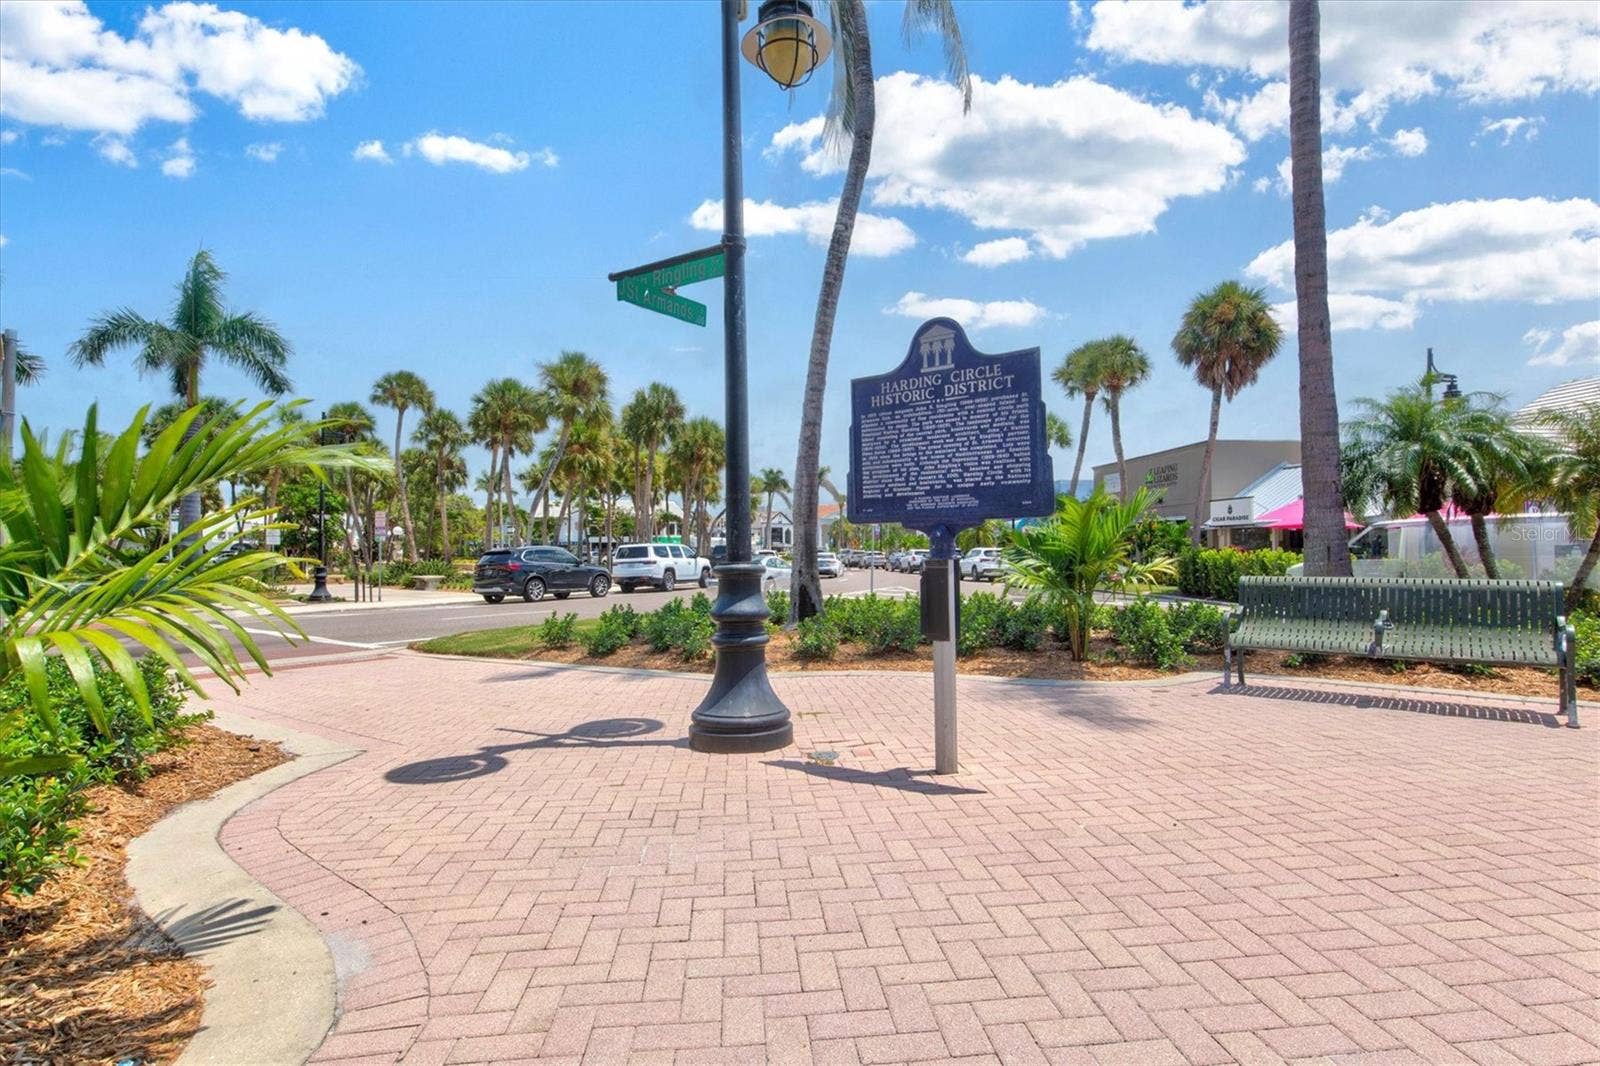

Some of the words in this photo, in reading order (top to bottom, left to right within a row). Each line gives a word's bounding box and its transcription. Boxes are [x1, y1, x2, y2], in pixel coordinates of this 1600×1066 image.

[652, 261, 706, 286] Ringling
[643, 294, 693, 318] Armands
[871, 387, 936, 408] HISTORIC
[944, 374, 1015, 398] DISTRICT
[881, 374, 942, 395] HARDING
[950, 364, 1003, 383] CIRCLE
